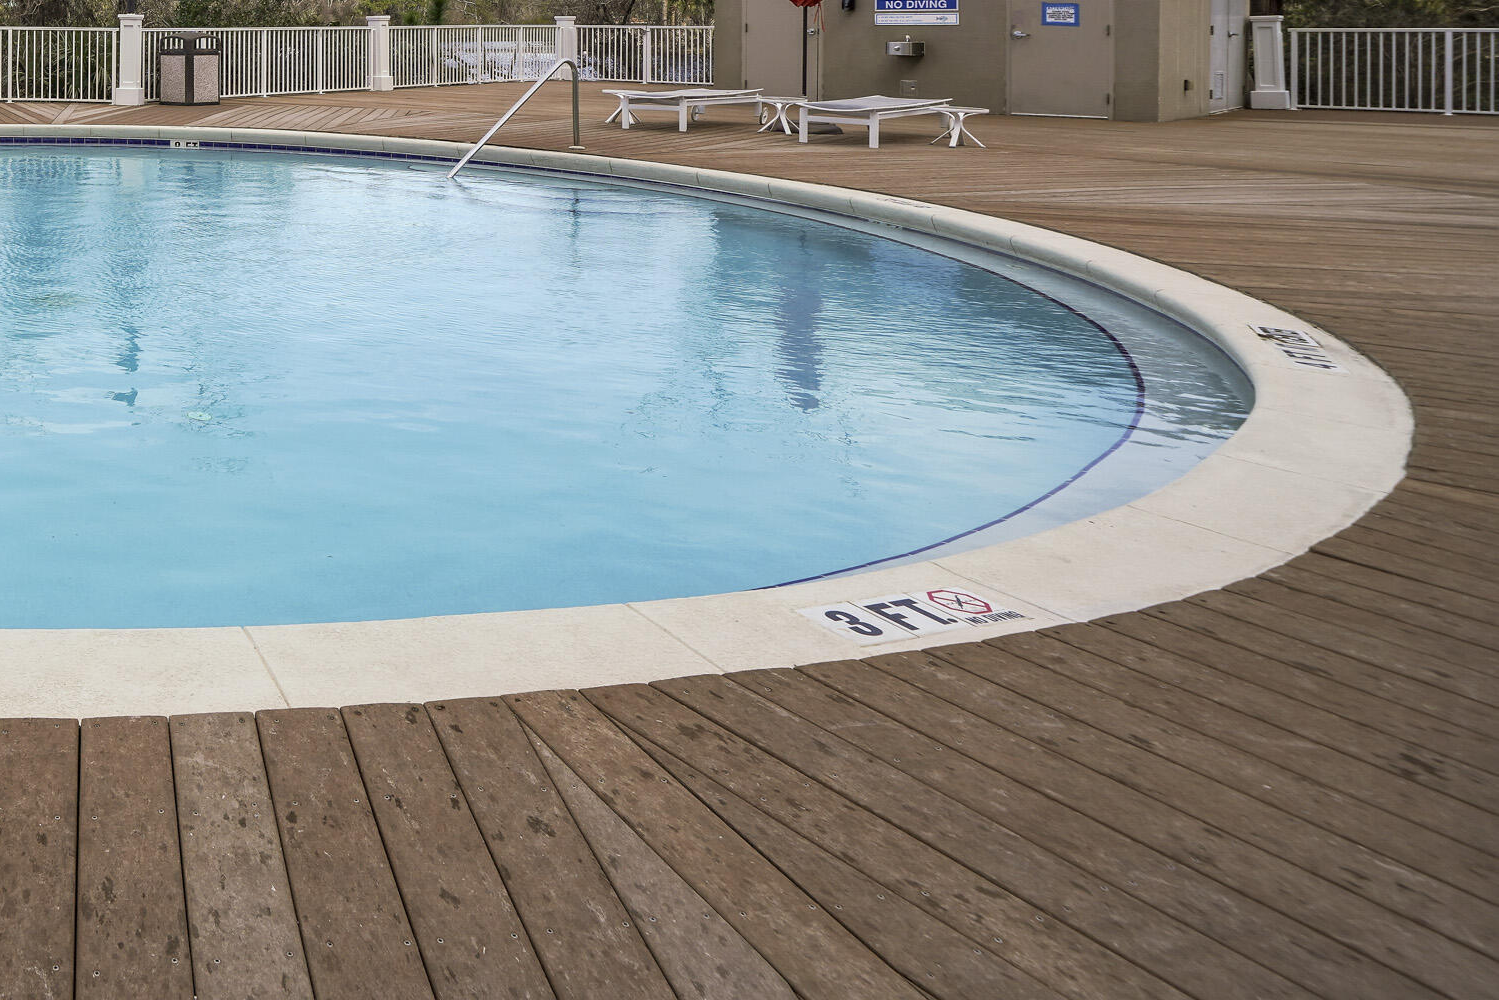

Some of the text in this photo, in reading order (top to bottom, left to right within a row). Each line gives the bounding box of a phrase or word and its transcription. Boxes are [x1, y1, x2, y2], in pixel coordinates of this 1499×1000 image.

[885, 0, 948, 9] NO DIVING
[824, 610, 883, 636] 3
